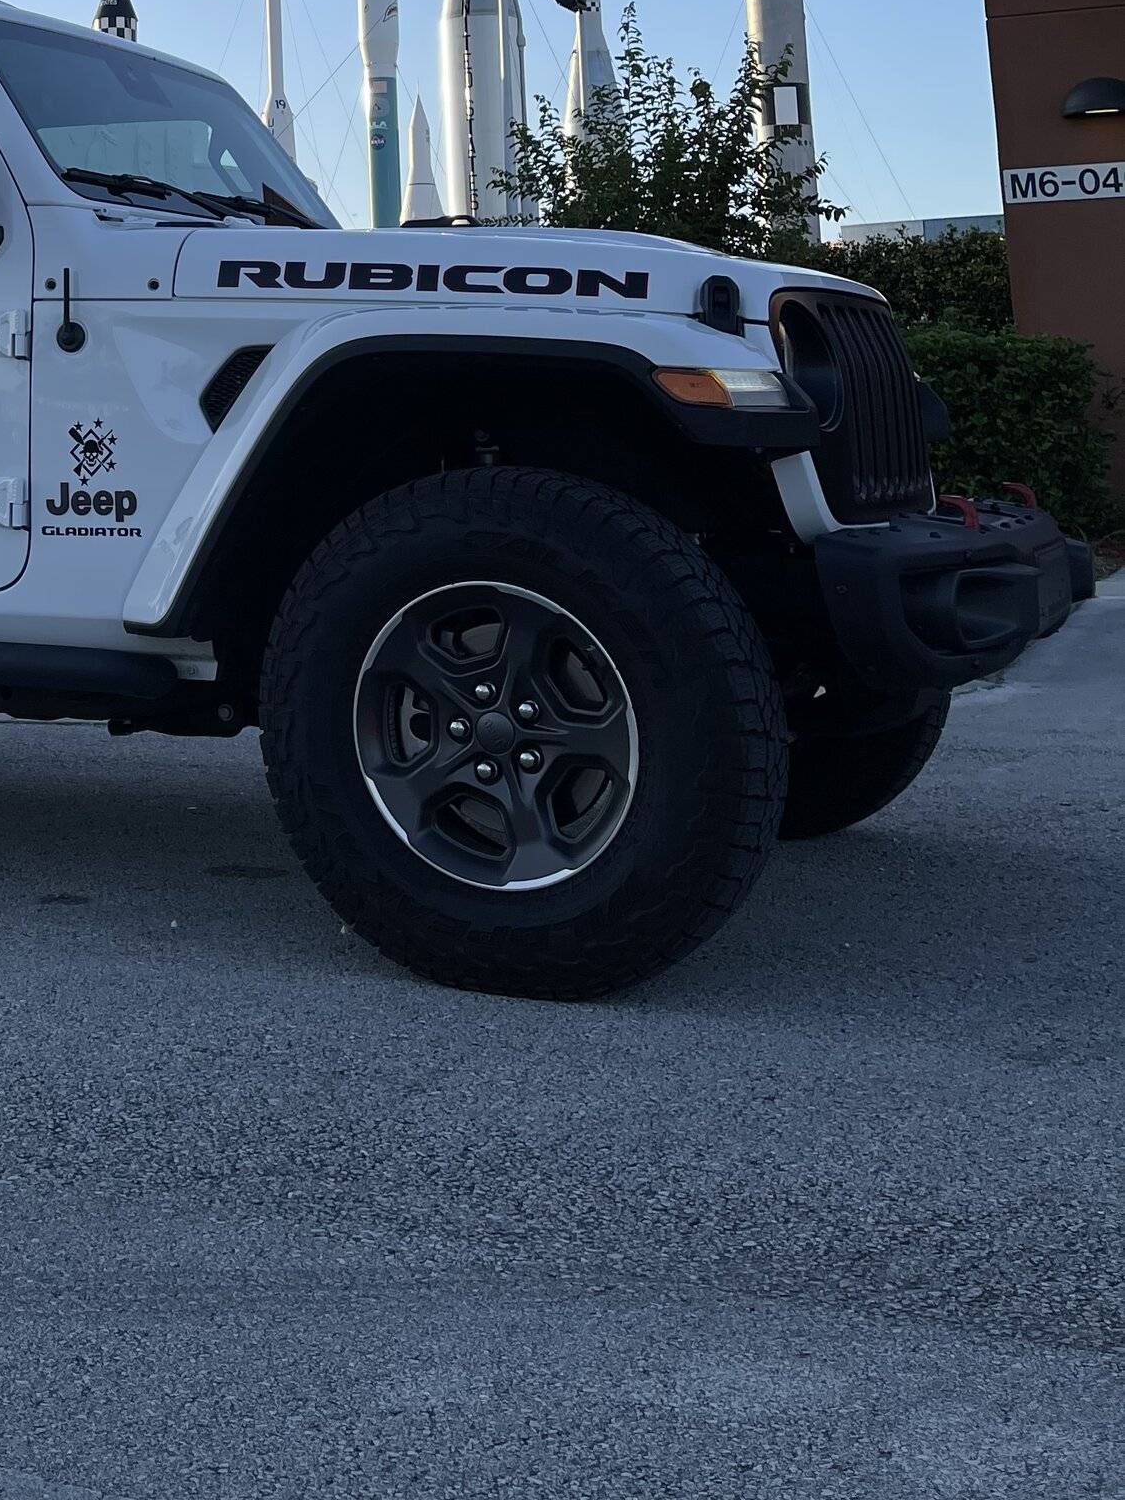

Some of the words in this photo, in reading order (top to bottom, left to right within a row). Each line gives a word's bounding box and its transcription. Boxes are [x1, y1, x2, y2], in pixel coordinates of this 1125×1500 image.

[275, 99, 286, 109] 19
[1010, 167, 1125, 199] M6-04
[216, 260, 650, 299] RUBICON
[46, 482, 137, 522] Jeep
[41, 525, 142, 537] GLADIATOR
